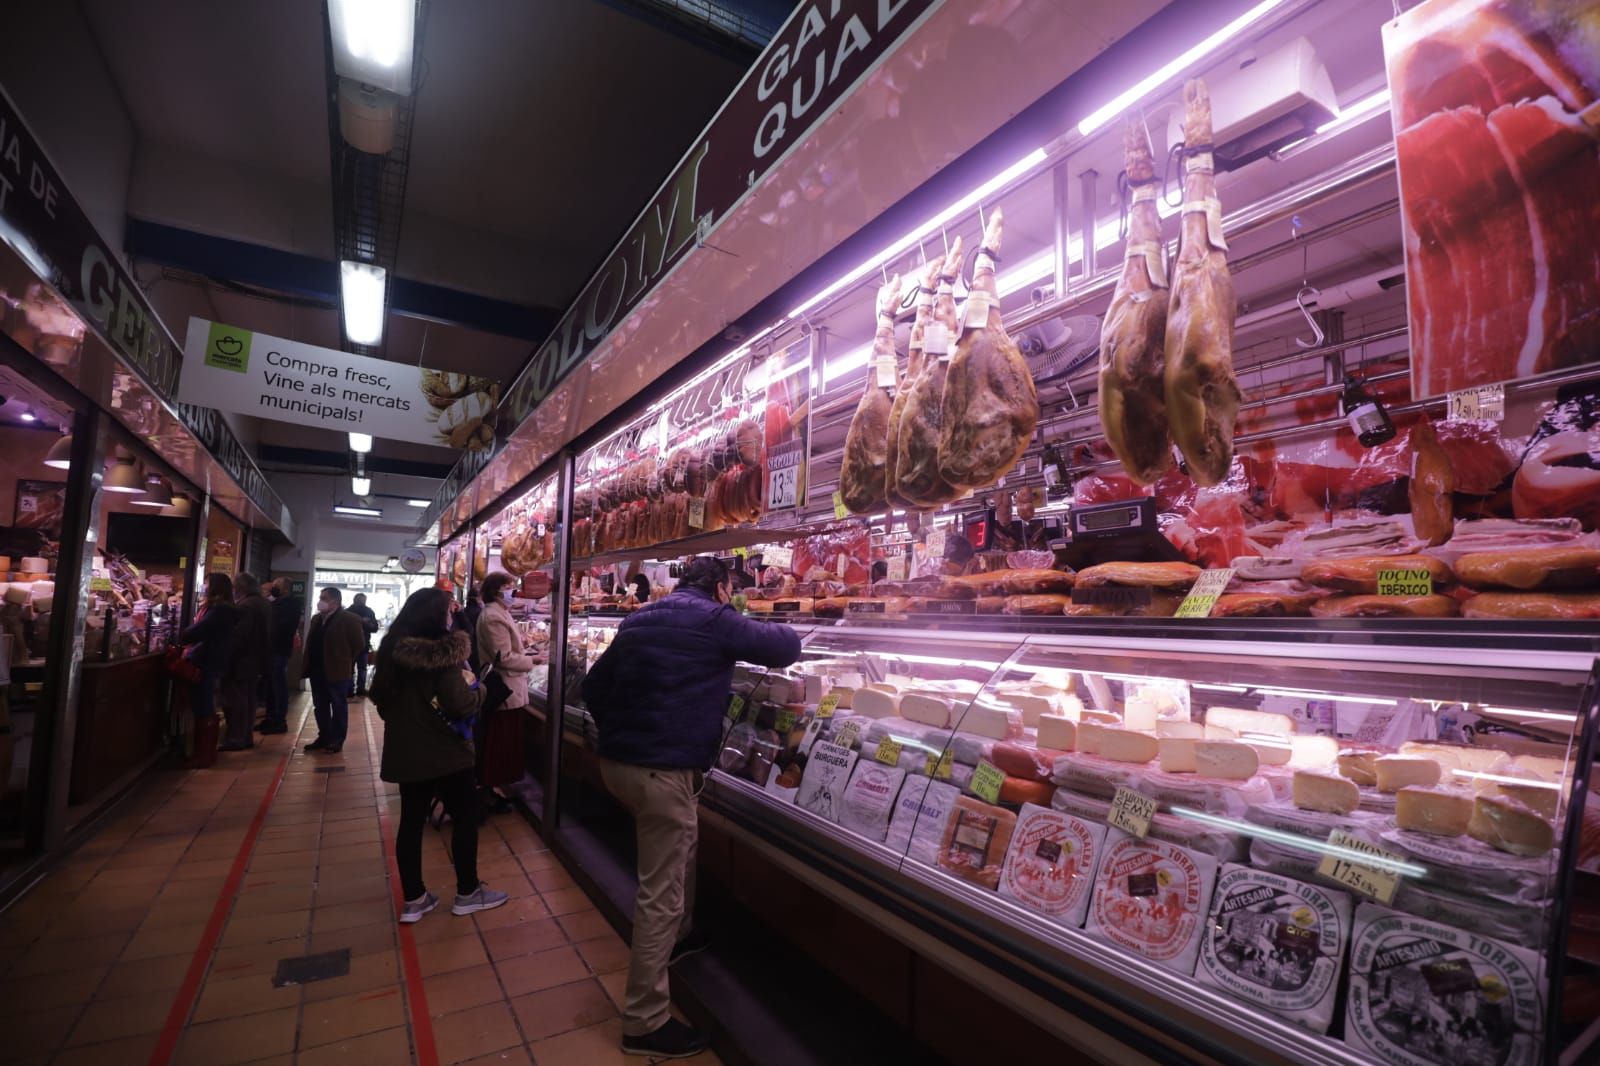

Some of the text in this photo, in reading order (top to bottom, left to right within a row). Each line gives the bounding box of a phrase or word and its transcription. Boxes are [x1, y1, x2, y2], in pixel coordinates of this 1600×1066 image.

[0, 115, 21, 176] A
[30, 159, 58, 221] DE
[511, 139, 709, 424] COLOM
[266, 351, 391, 390] Compra fresc,
[264, 371, 411, 411] Vine als mercats
[260, 394, 364, 423] municipals!
[814, 751, 848, 769] BURGUERA
[821, 742, 850, 757] FORMATGES
[1115, 796, 1152, 818] SEMI
[1070, 819, 1091, 868] TORRALBA
[1114, 853, 1153, 874] ARTESANO
[1169, 848, 1198, 904] TORRALBA
[1220, 872, 1249, 889] mahón
[1294, 883, 1338, 948] TORRALBA
[1224, 888, 1274, 911] ARTESANO
[1375, 941, 1441, 969] ARTESANO
[1215, 969, 1264, 999] CARDONA
[1470, 935, 1536, 1021] TORRALBA
